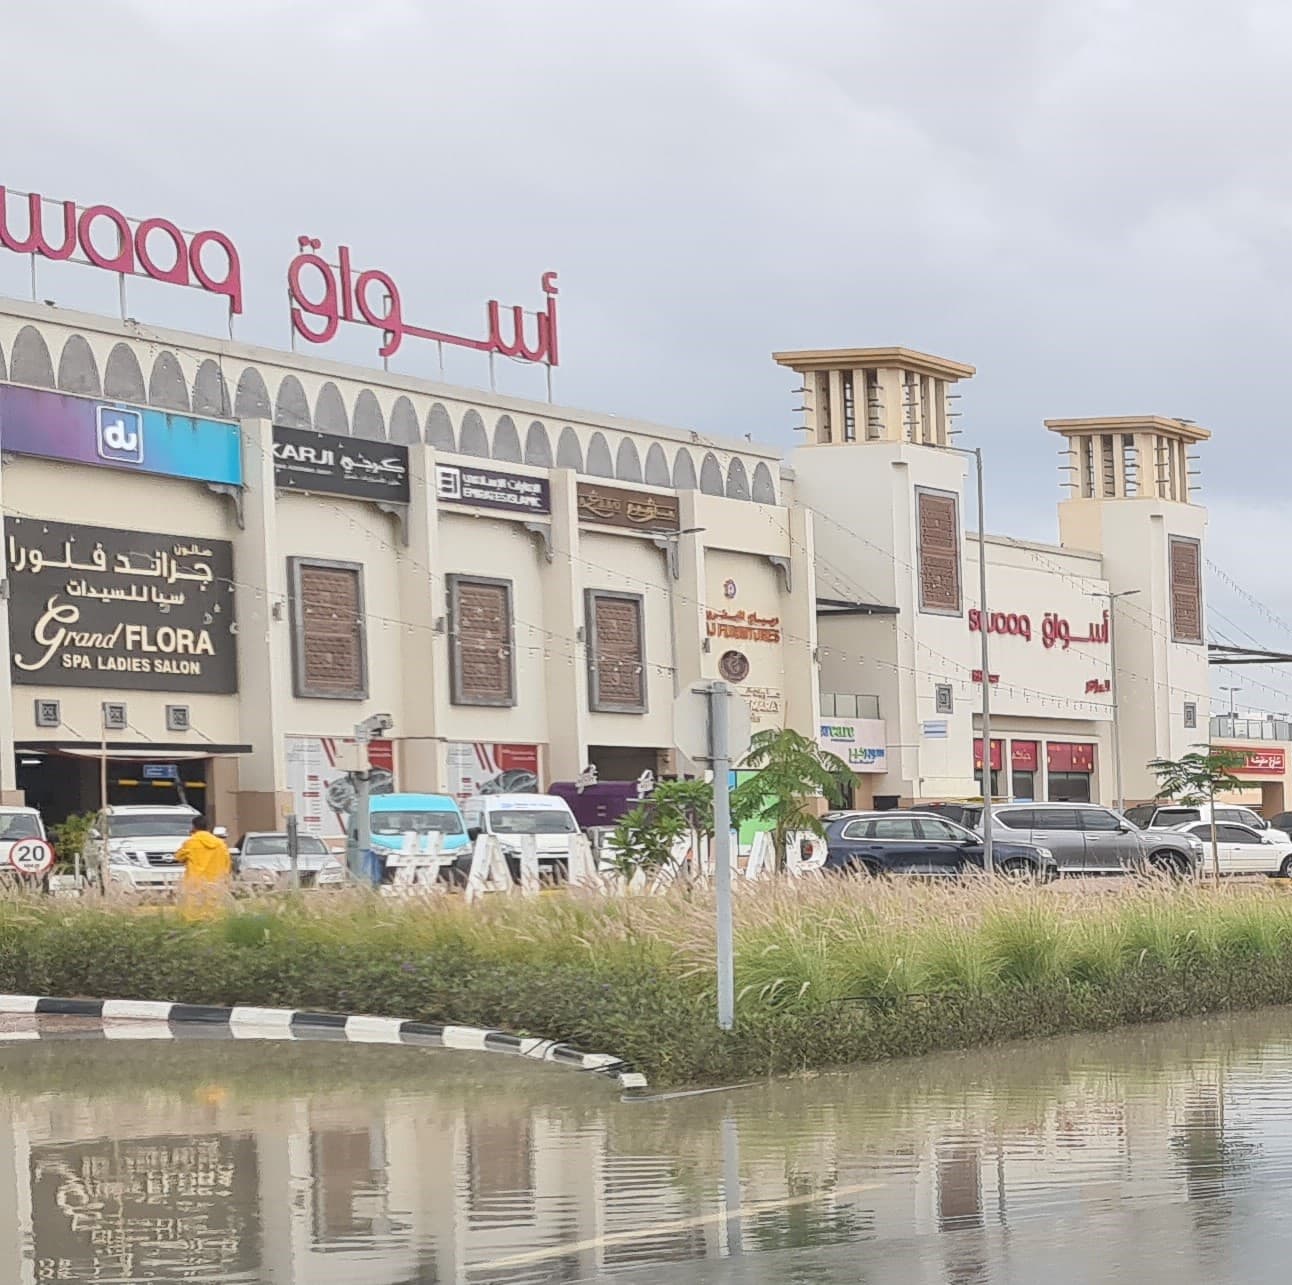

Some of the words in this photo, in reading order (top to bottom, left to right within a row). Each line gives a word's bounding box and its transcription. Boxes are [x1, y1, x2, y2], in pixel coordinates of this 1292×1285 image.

[288, 235, 559, 366] أسواق
[104, 419, 138, 451] du
[9, 535, 107, 573] فلورا
[114, 550, 214, 591] جراند
[66, 578, 148, 603] للسيدات
[14, 594, 123, 671] Grand
[125, 624, 216, 656] FLORA
[1041, 609, 1109, 649] أسواق
[62, 653, 92, 669] SPA
[98, 655, 150, 672] LADIES
[154, 659, 201, 675] SALON
[18, 845, 45, 862] 20
